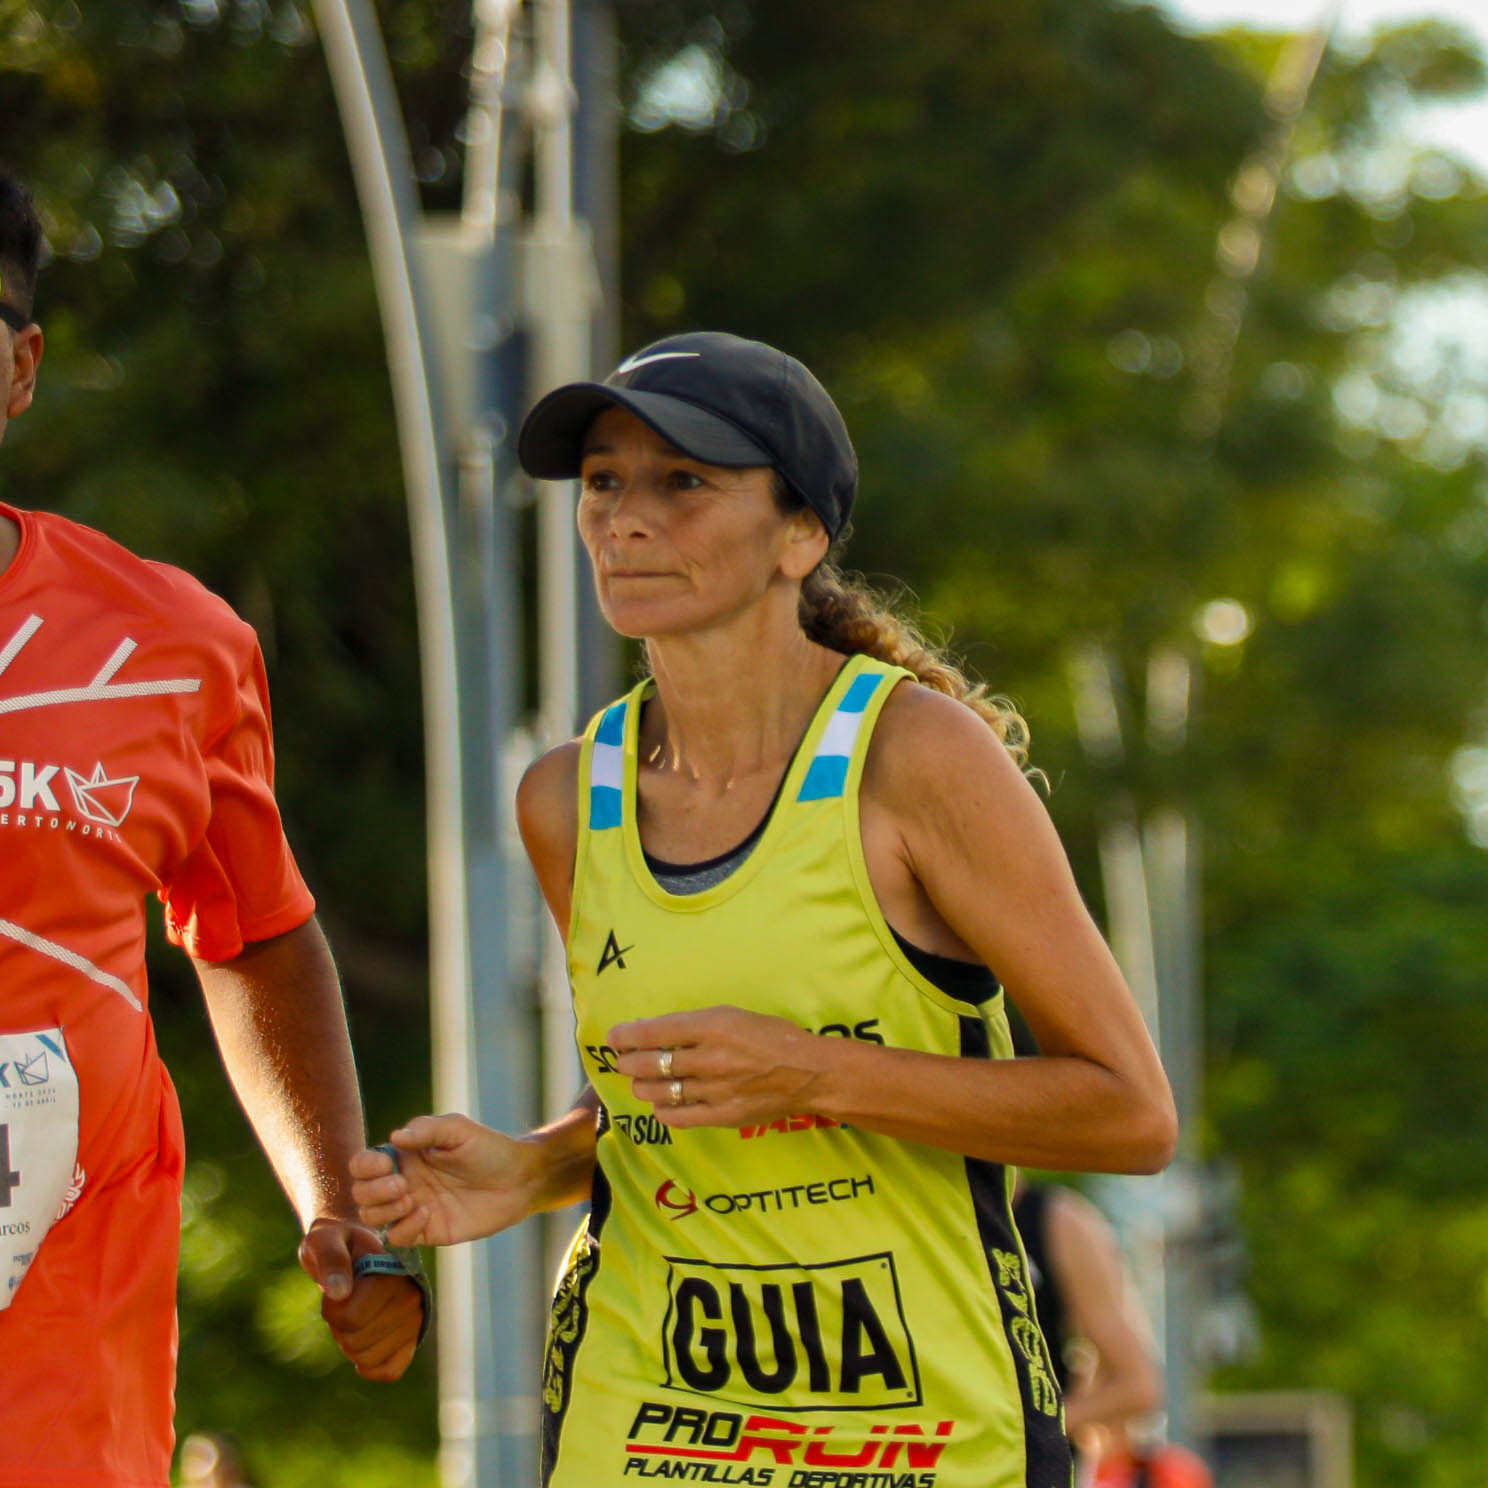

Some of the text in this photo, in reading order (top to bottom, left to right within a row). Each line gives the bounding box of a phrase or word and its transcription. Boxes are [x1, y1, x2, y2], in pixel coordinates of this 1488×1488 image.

[704, 1174, 875, 1214] OPTITECH
[0, 1221, 31, 1237] rcos
[673, 1276, 907, 1394] GUIA
[624, 1458, 775, 1487] PLANTILLAS
